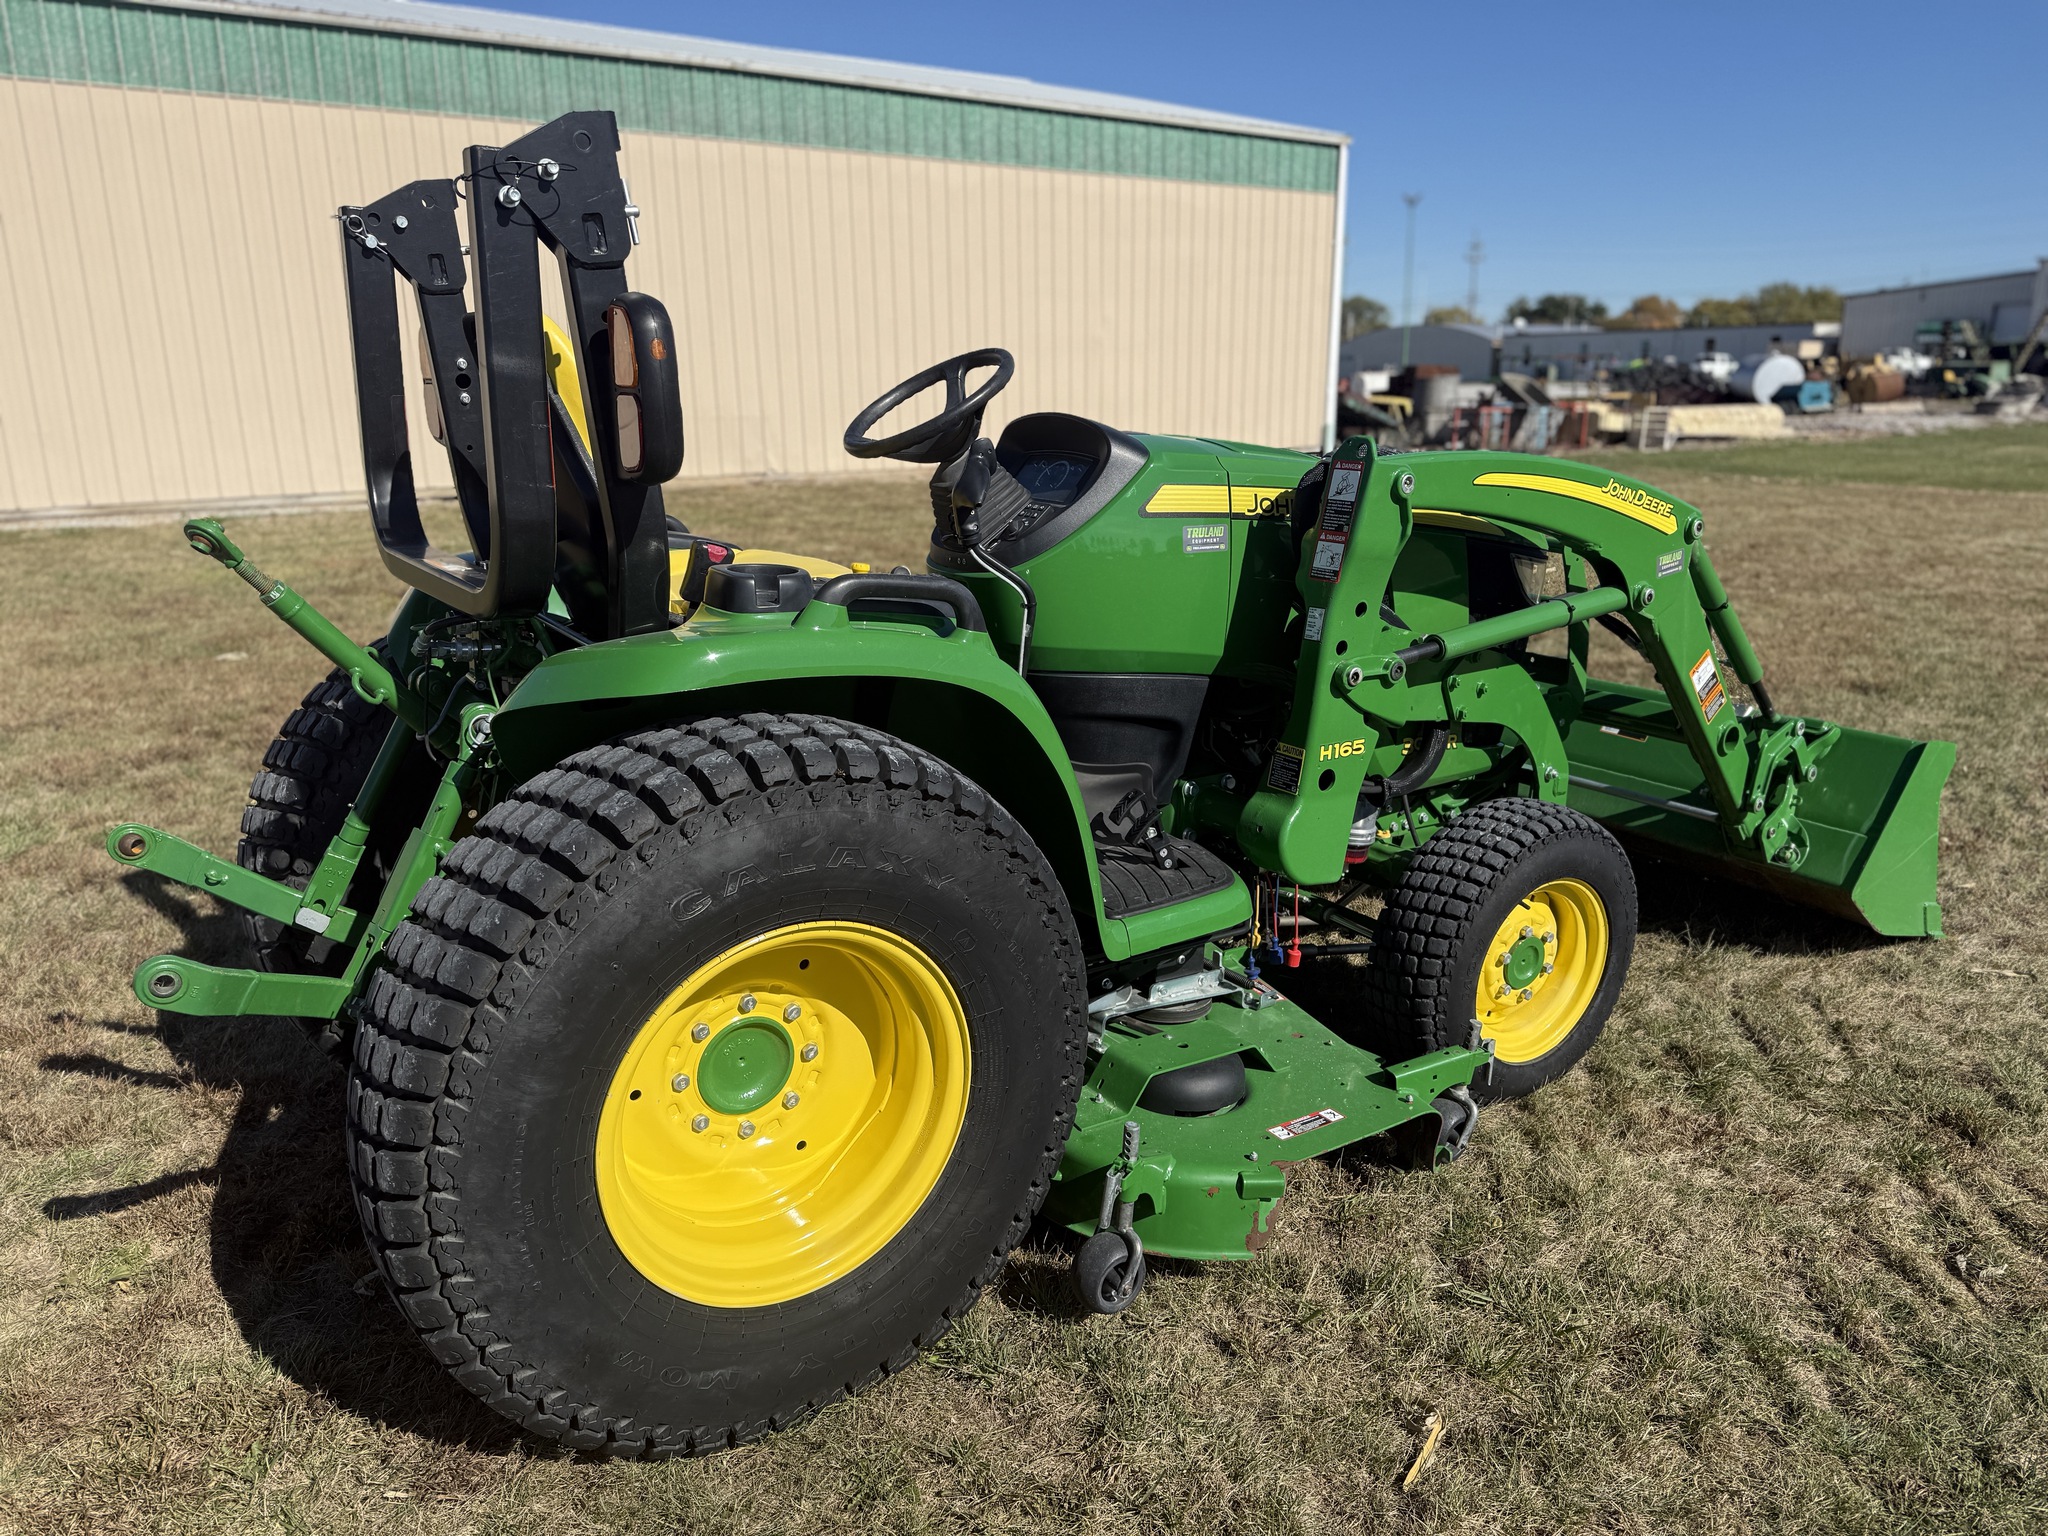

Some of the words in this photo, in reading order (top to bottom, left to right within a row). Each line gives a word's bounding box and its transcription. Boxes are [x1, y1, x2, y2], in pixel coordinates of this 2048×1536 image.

[1341, 462, 1361, 470] DANGER
[1601, 478, 1636, 504] JOHN
[1633, 488, 1674, 517] DEERE
[1186, 526, 1224, 538] TRULAND
[1659, 550, 1682, 566] TRULAND
[1283, 744, 1304, 759] CAUTION
[1318, 738, 1366, 762] H165
[668, 844, 957, 923] GALAXY
[788, 1214, 984, 1380] MIGHTY
[613, 1346, 743, 1392] MOW
